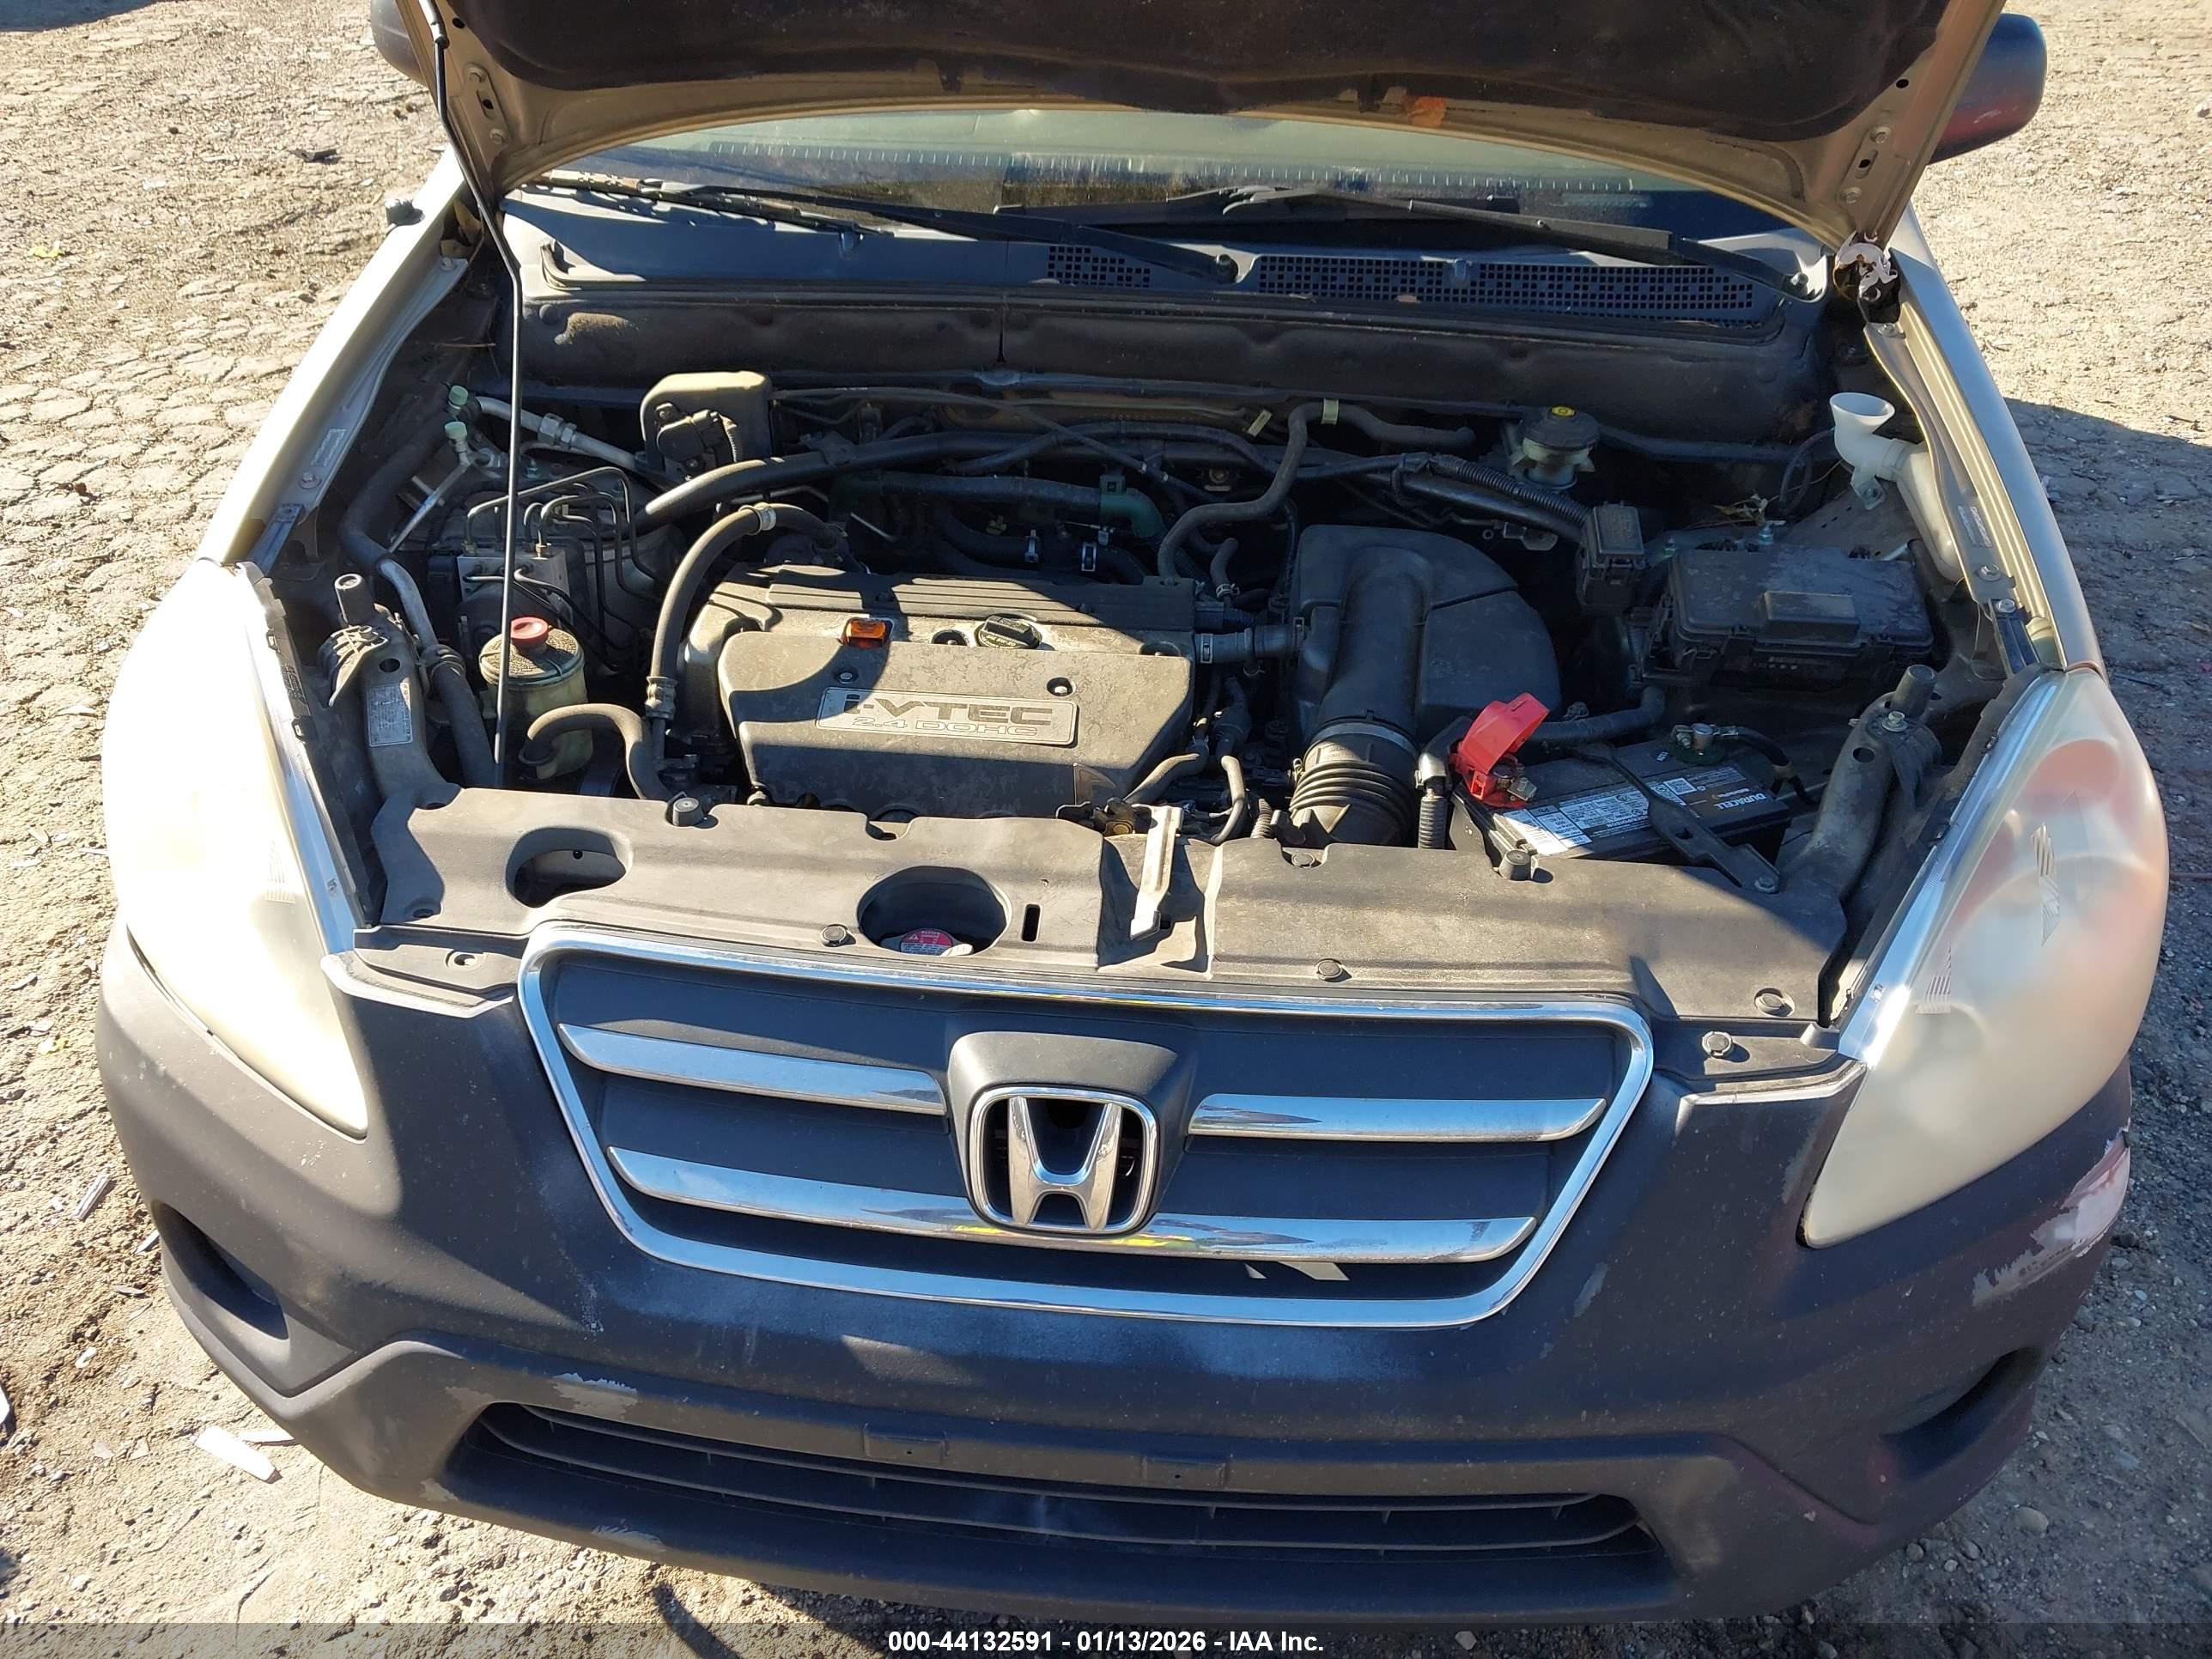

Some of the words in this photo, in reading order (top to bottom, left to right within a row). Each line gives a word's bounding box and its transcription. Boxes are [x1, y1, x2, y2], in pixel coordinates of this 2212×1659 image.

[843, 693, 1054, 726] i-VTEC
[851, 716, 908, 729] 2.4
[915, 720, 1039, 737] DOHC
[1713, 793, 1767, 810] DURACELL
